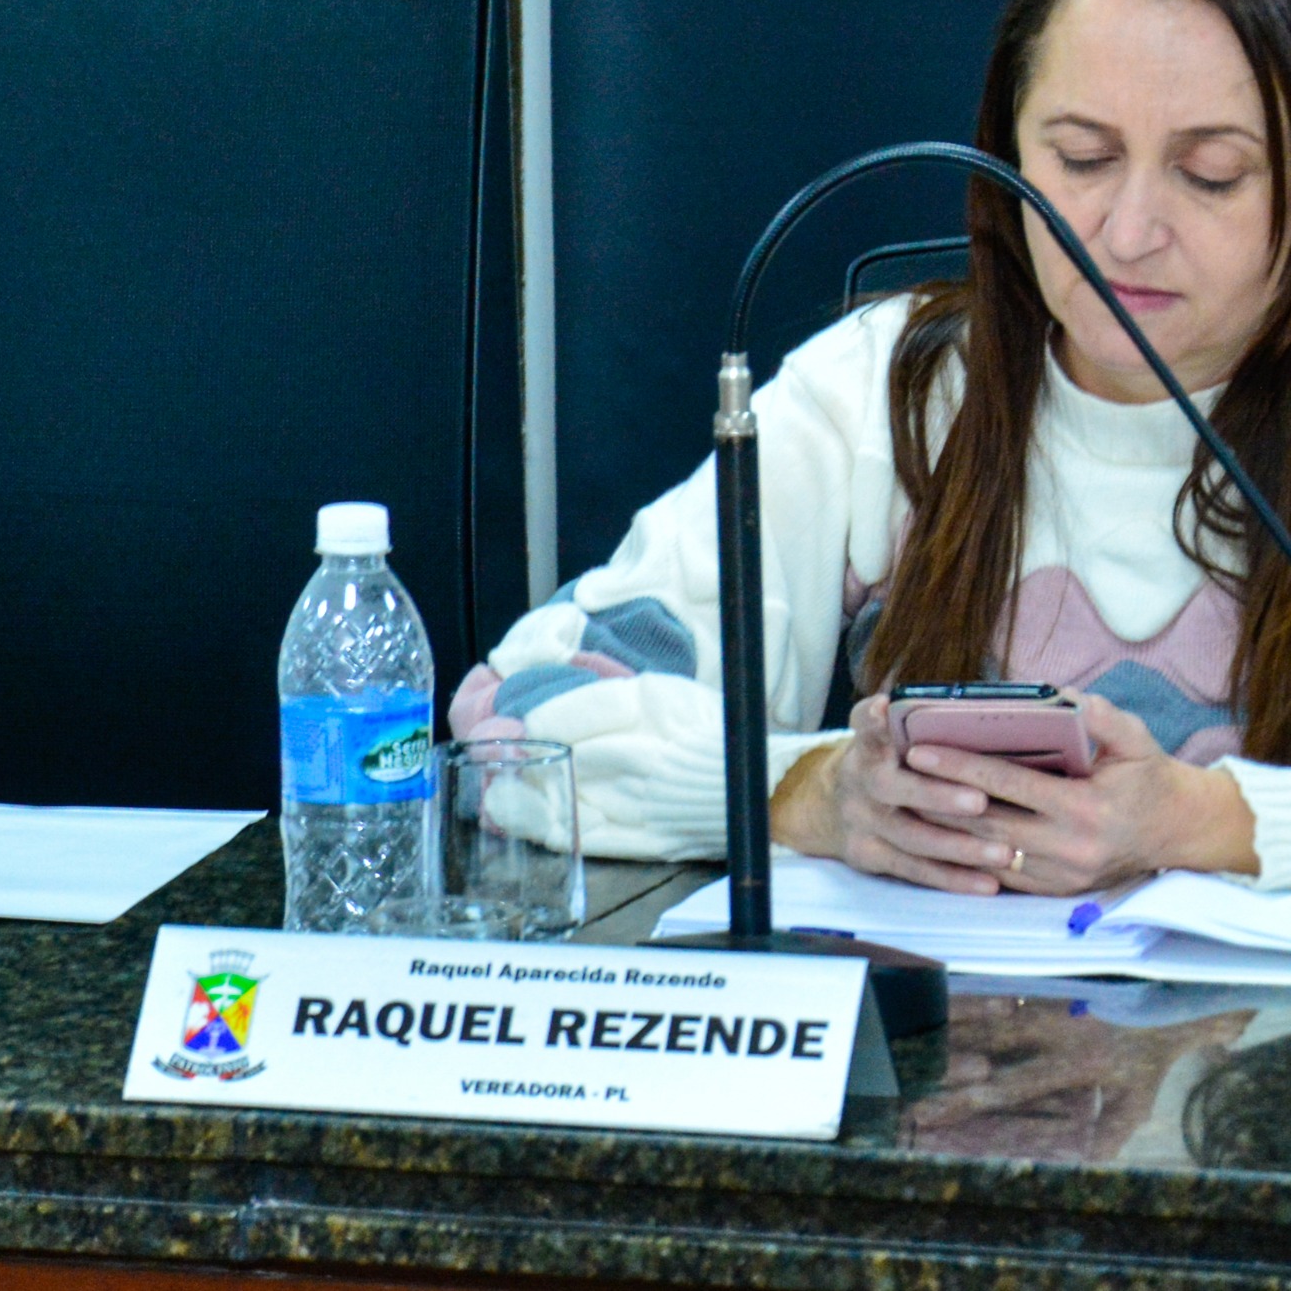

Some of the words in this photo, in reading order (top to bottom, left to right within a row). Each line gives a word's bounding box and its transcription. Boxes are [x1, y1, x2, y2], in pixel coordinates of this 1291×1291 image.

[409, 958, 492, 982] Raquel
[498, 962, 617, 988] Aparecida
[624, 968, 728, 990] Rezende
[291, 995, 526, 1047] RAQUEL
[545, 1007, 831, 1061] REZENDE
[460, 1078, 587, 1101] VEREADORA
[605, 1086, 630, 1103] PL
